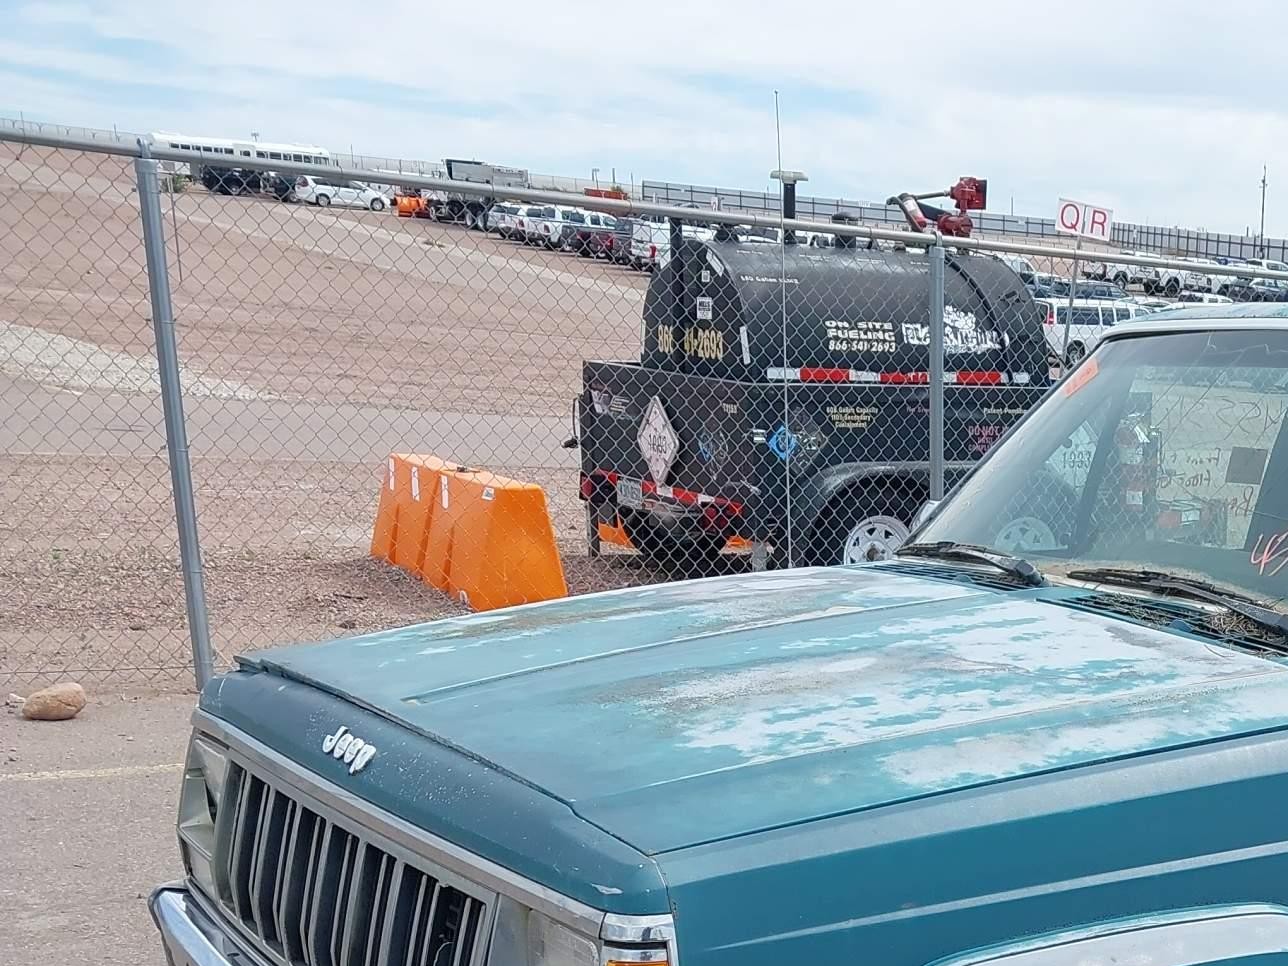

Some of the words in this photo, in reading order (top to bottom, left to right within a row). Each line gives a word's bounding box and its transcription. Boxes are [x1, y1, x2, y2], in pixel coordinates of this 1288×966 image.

[824, 320, 849, 328] ON
[857, 321, 893, 330] SITE
[827, 328, 896, 341] FUELING
[322, 725, 377, 774] Jeep
